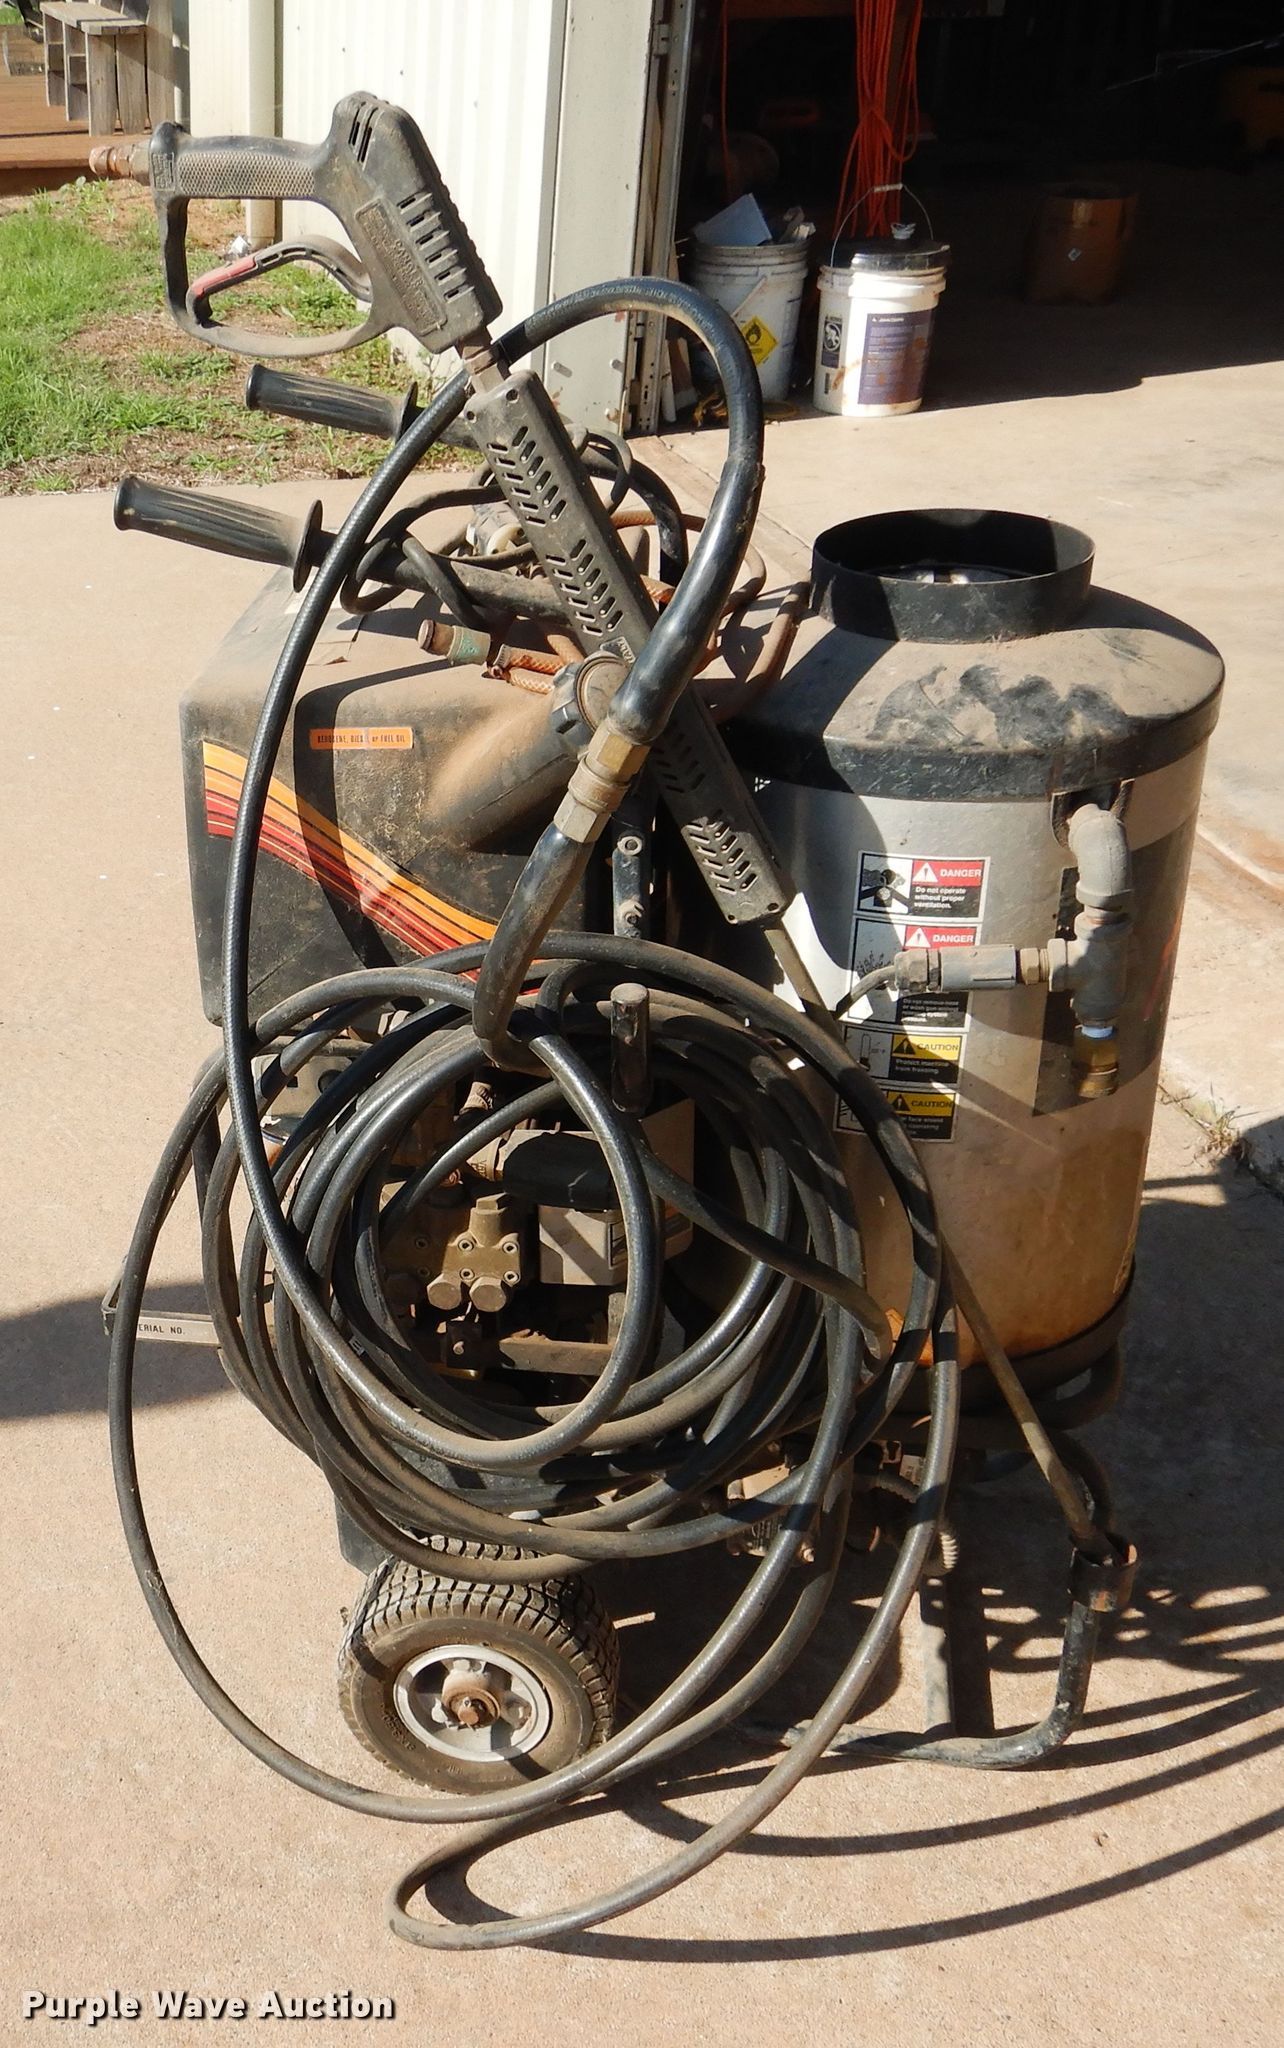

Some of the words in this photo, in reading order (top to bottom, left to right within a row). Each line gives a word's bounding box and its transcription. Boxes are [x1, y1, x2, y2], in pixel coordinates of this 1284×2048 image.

[380, 734, 394, 743] FUEL
[396, 734, 405, 743] OIL
[940, 868, 982, 877] DANGER
[941, 895, 965, 903] proper
[913, 901, 952, 909] ventilation.
[932, 934, 974, 943] DANGER
[917, 1043, 959, 1052] CAUTION
[911, 1099, 956, 1109] CAUTION
[138, 1323, 164, 1333] ERIAL
[170, 1326, 185, 1335] NO.
